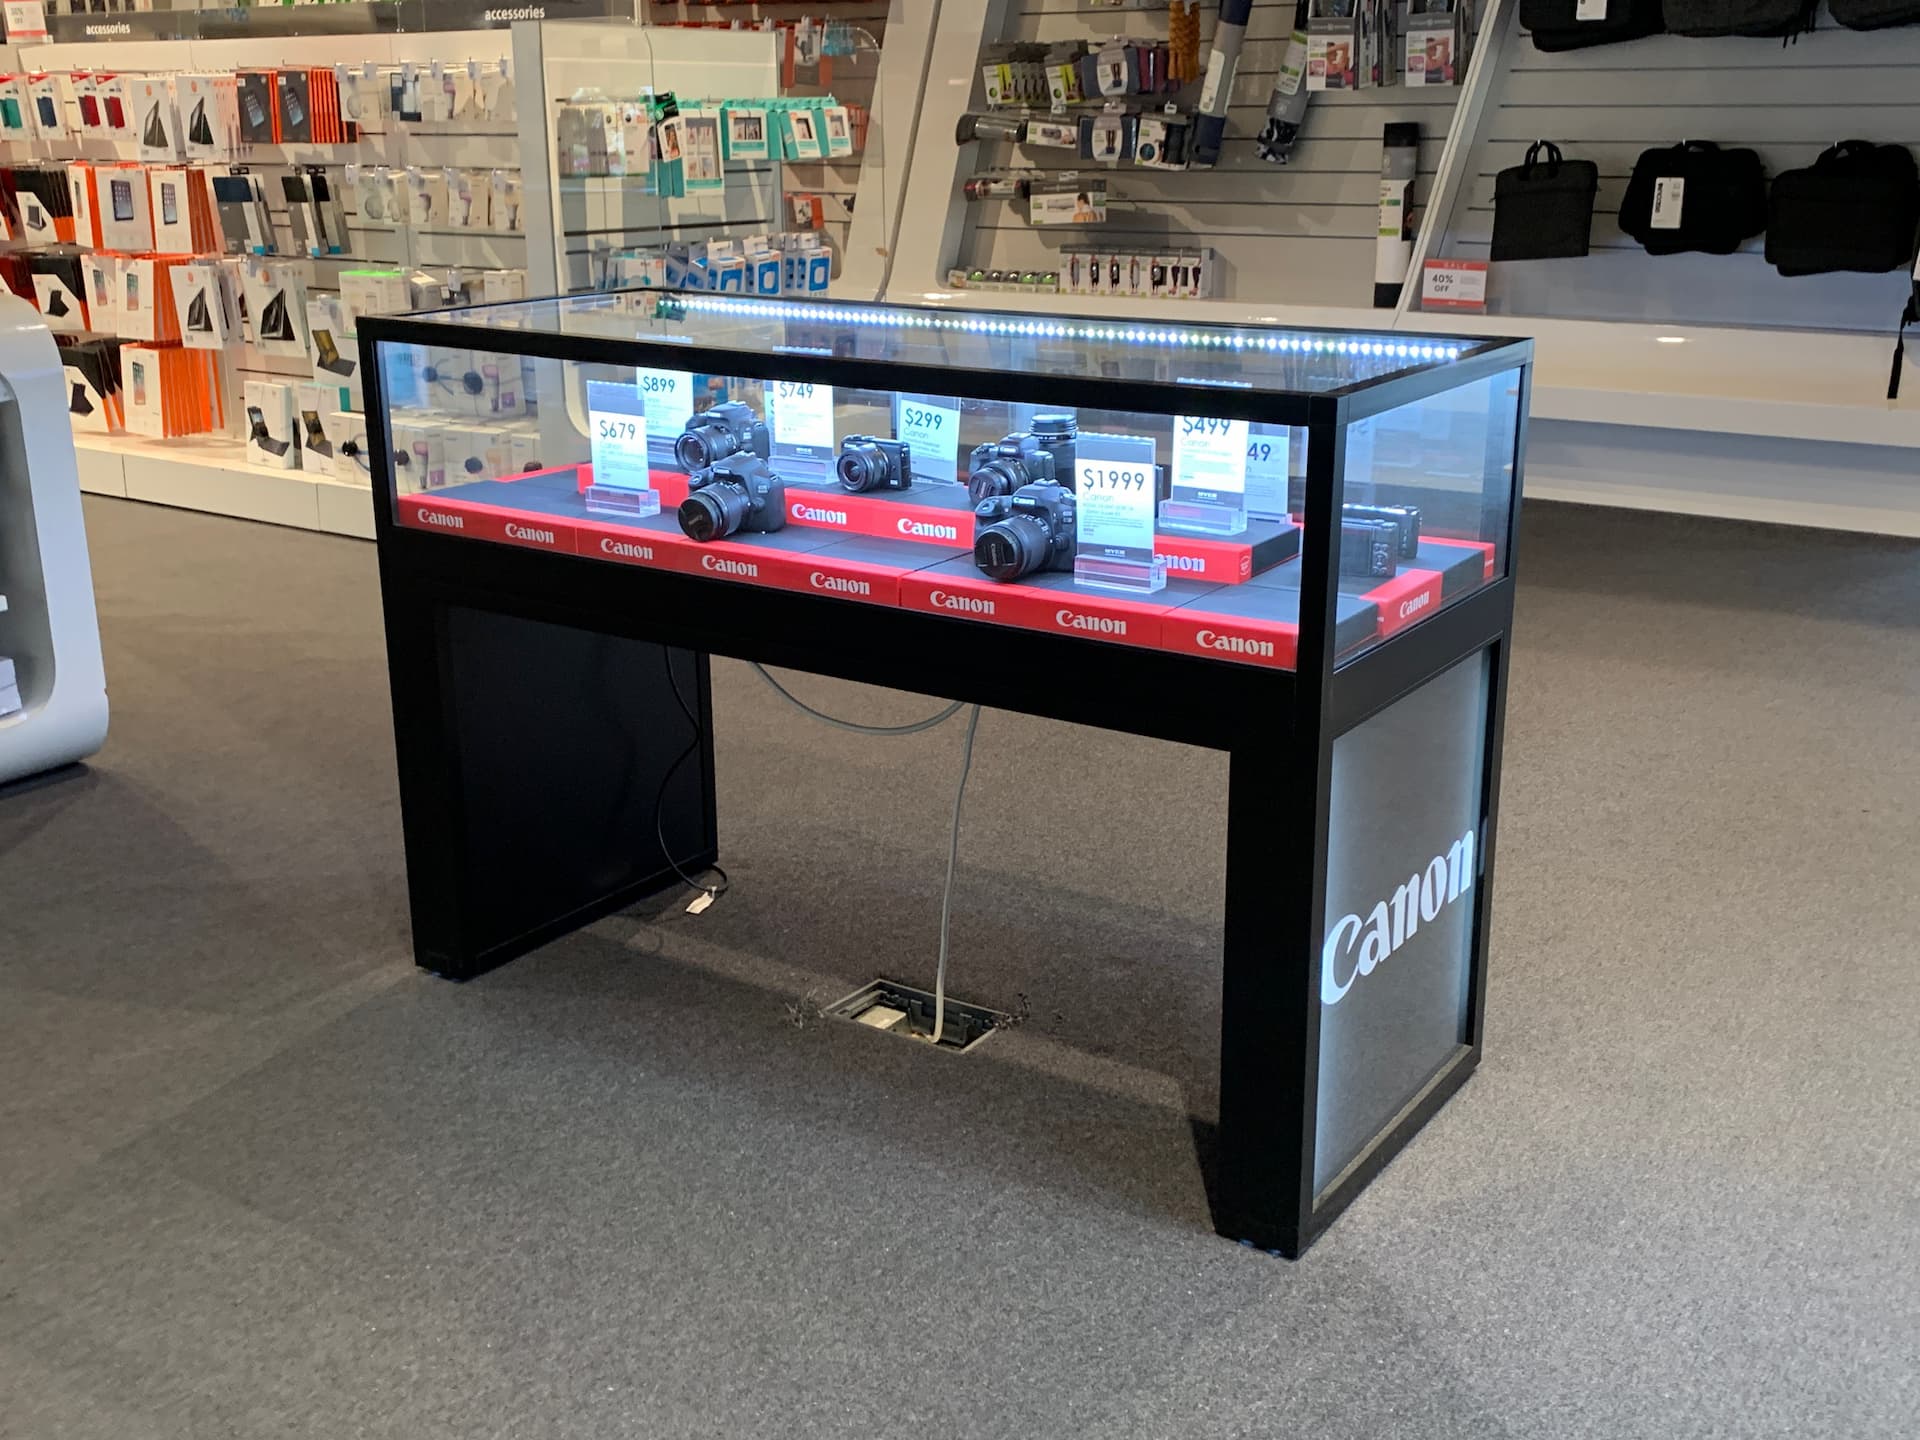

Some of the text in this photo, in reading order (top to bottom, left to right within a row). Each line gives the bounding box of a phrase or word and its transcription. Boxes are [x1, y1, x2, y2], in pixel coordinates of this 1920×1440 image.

[484, 4, 545, 20] accessories
[85, 22, 131, 35] accessories
[1432, 274, 1454, 284] 40%
[1434, 284, 1449, 293] OFF
[642, 375, 676, 393] $899
[779, 382, 814, 399] $749
[599, 419, 637, 440] $679
[904, 407, 943, 431] $299
[1182, 416, 1231, 436] $499
[1247, 442, 1272, 462] 49
[1082, 467, 1146, 491] $1999
[417, 508, 465, 529] Canon
[790, 503, 848, 525] Canon
[504, 522, 555, 545] Canon
[897, 517, 958, 541] Canon
[600, 537, 654, 561] Canon
[701, 554, 759, 578] Canon
[1154, 553, 1206, 573] anon
[810, 571, 871, 596] Canon
[929, 589, 996, 616] Canon
[1399, 590, 1431, 619] Canon
[1055, 609, 1127, 636] Canon
[1195, 629, 1275, 658] Canon
[1320, 829, 1475, 1006] Canon
